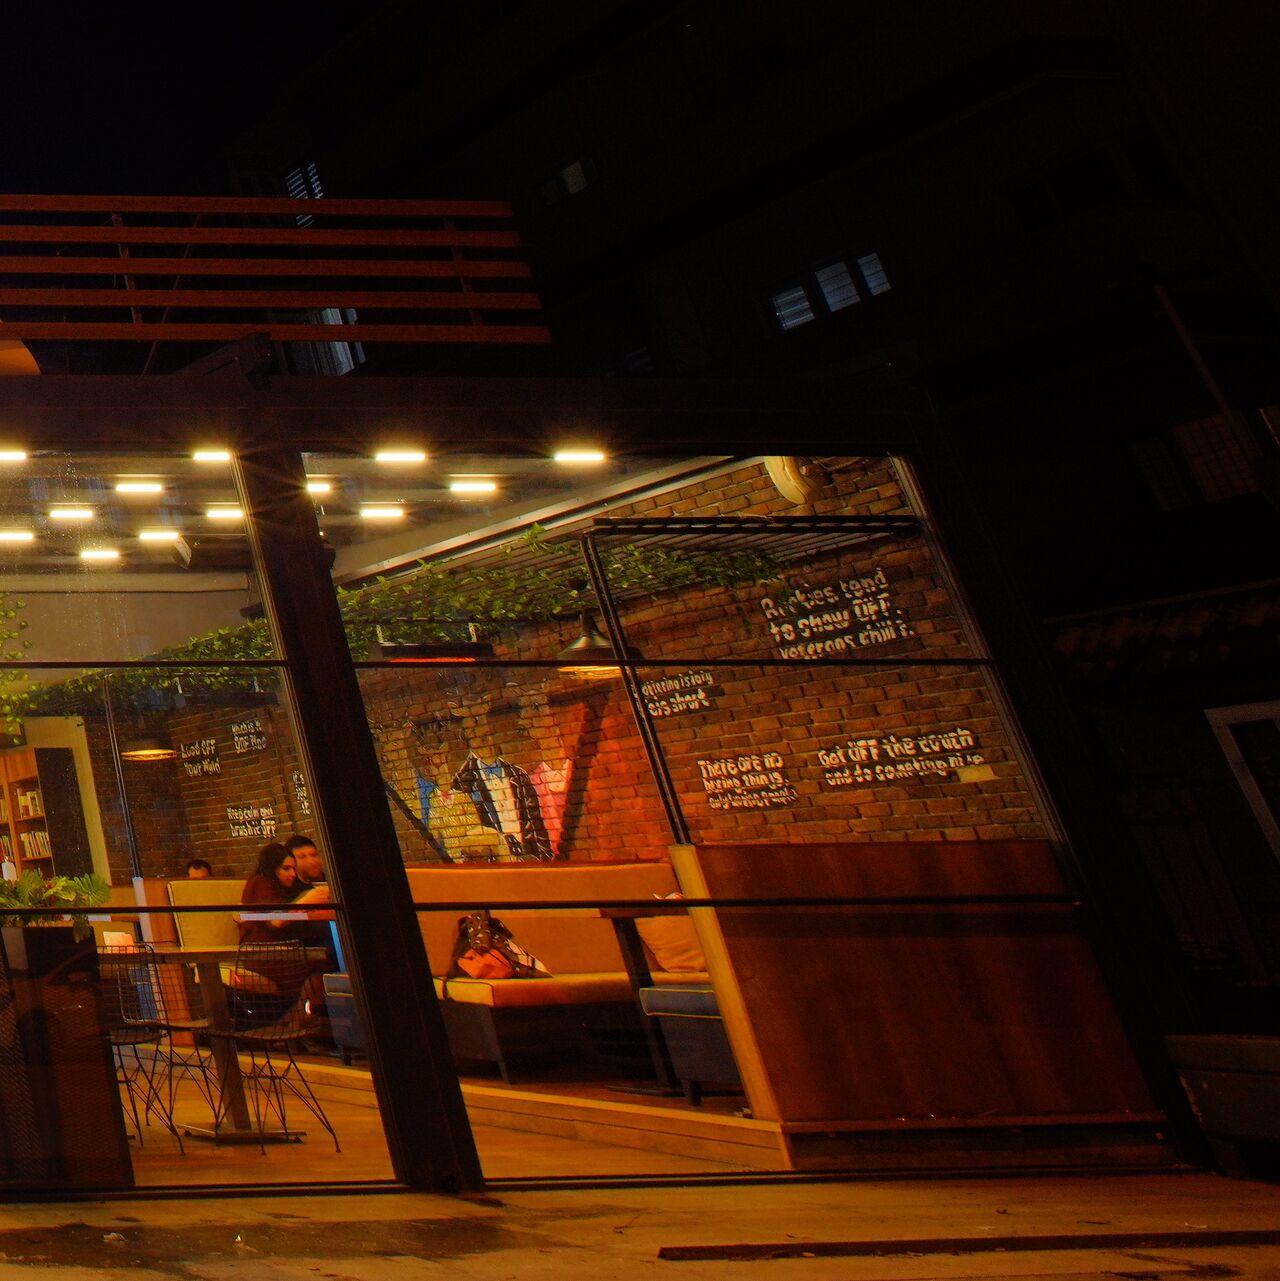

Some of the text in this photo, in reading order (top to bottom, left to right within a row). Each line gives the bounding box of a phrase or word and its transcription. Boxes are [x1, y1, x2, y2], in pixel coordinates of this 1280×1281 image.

[770, 621, 796, 643] to
[797, 609, 851, 638] show
[847, 738, 882, 763] OFF
[882, 735, 918, 759] the
[696, 758, 739, 778] There
[763, 752, 785, 770] no
[854, 763, 874, 783] do
